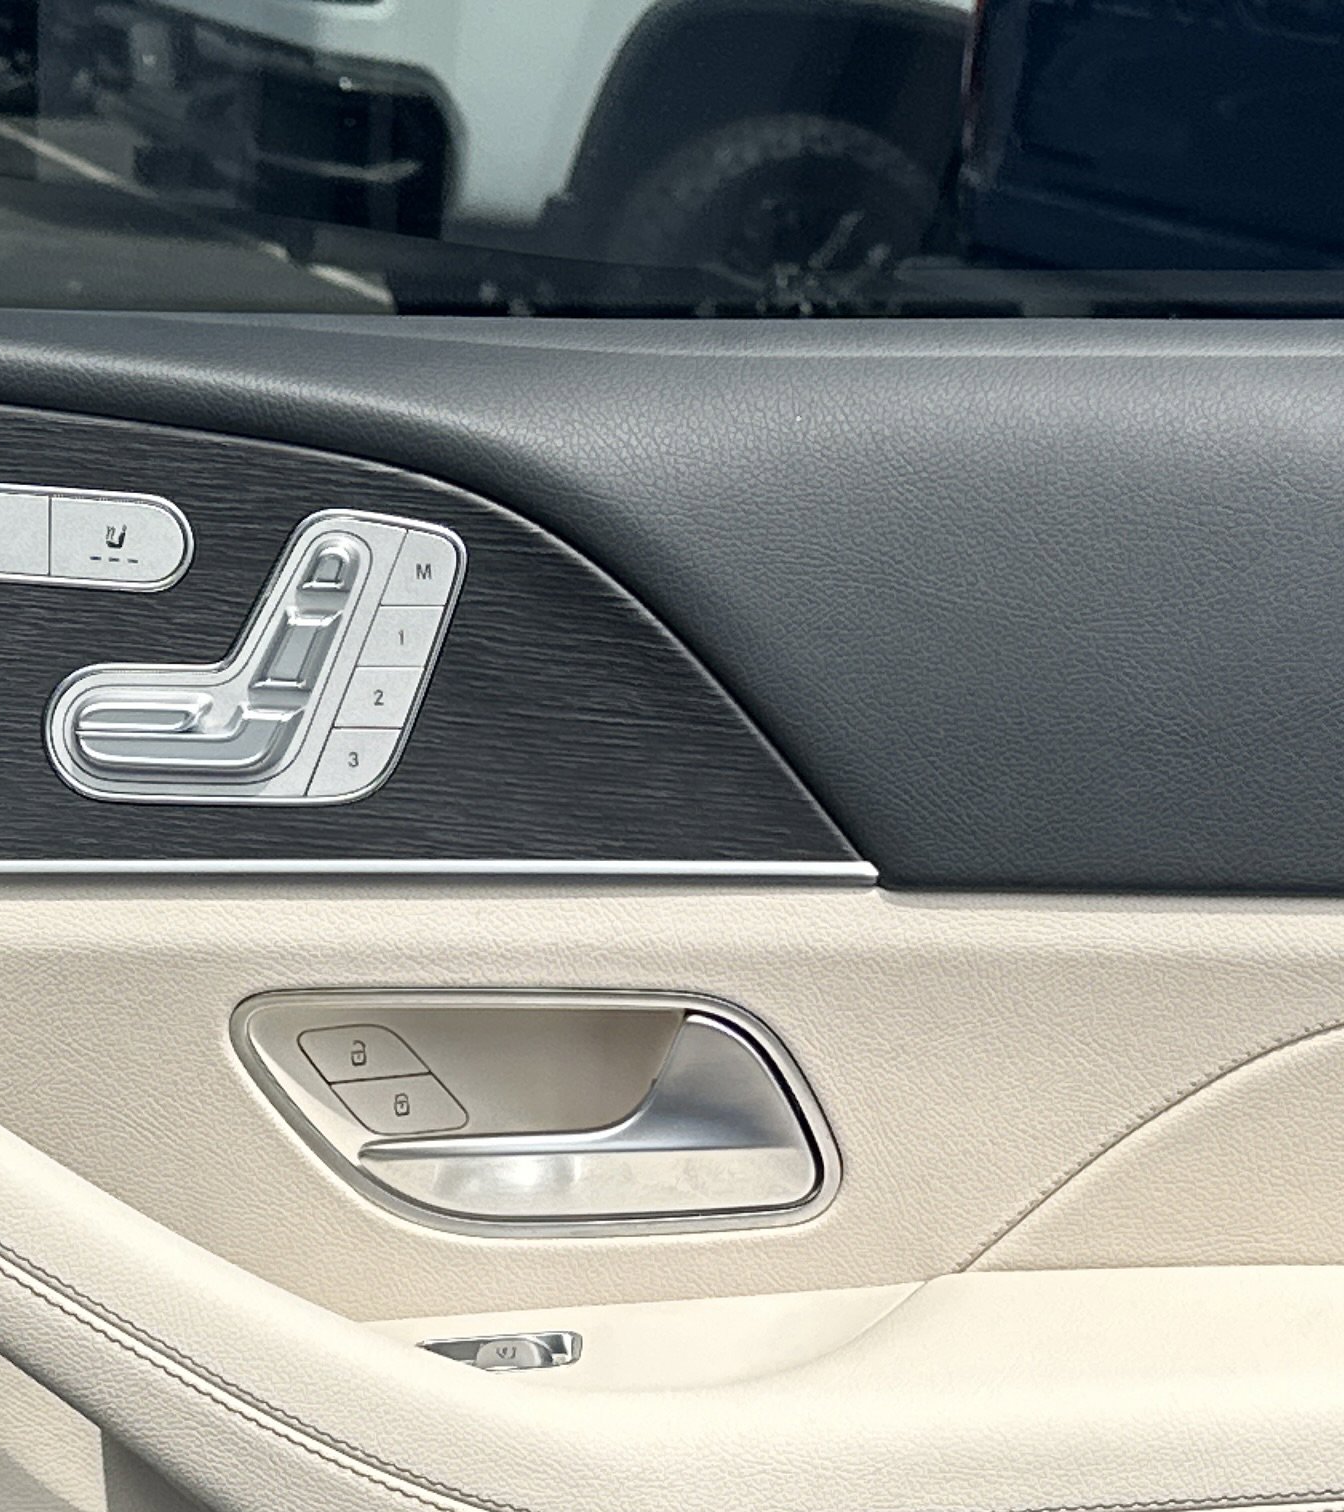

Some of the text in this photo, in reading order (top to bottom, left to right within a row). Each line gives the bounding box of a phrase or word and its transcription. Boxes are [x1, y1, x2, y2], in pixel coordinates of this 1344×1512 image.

[415, 563, 433, 580] M
[397, 629, 405, 645] 1
[372, 689, 385, 706] 2
[347, 751, 360, 768] 3
